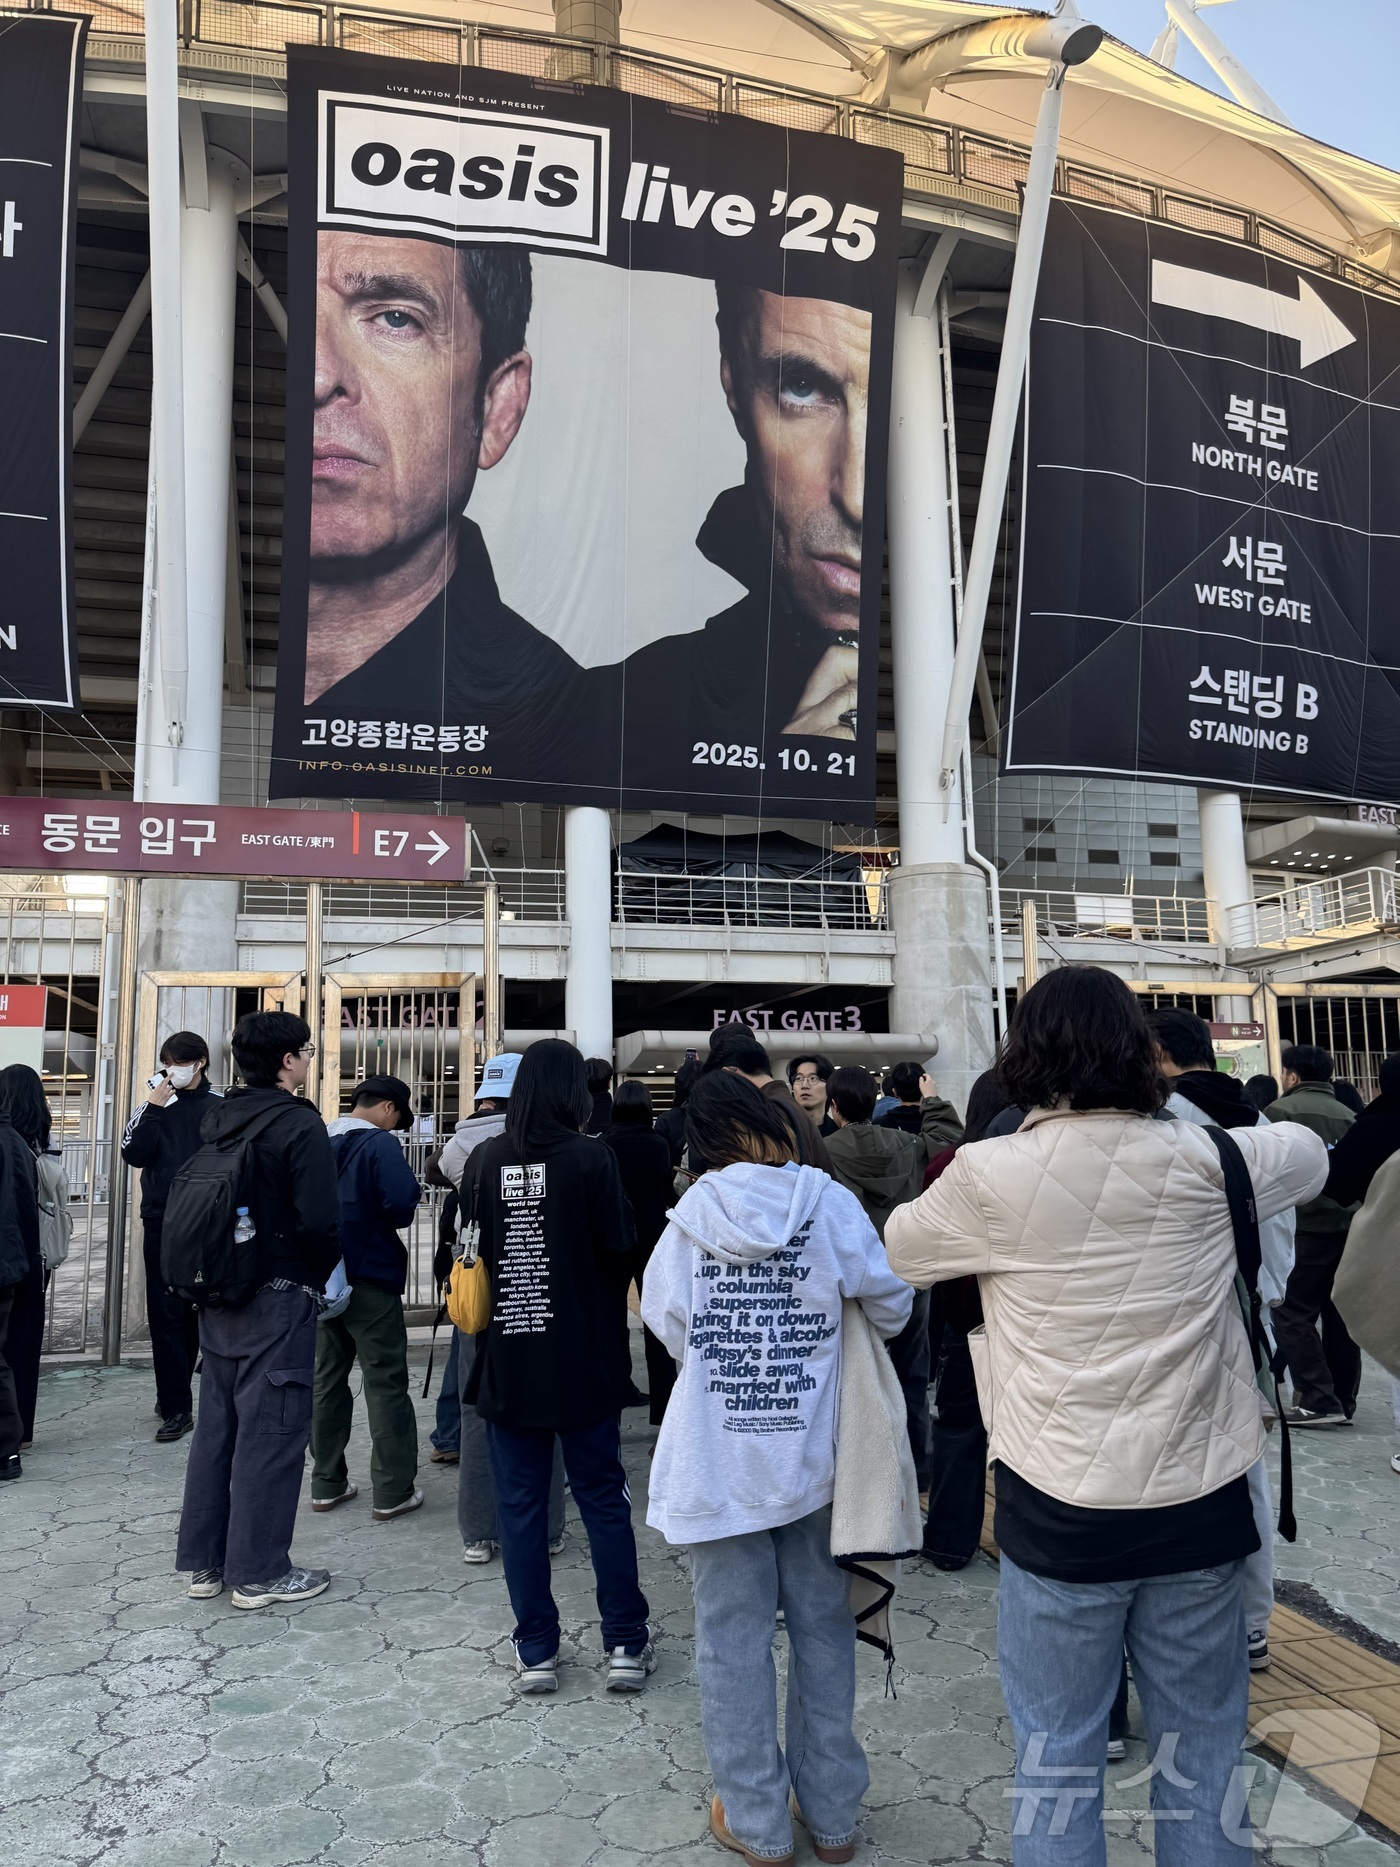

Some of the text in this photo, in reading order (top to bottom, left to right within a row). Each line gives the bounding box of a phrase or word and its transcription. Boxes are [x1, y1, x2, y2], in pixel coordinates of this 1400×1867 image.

[386, 84, 545, 111] LIVE NATION AND SJM PRESENT
[350, 142, 880, 262] oasis live '25
[1224, 394, 1289, 451] 북문
[1191, 441, 1319, 491] NORTH GATE
[1221, 536, 1287, 586] 서문
[1194, 583, 1312, 624] WEST GATE
[1188, 665, 1319, 720] 스탠딩 B
[301, 719, 489, 753] 고양종합운동장
[1188, 719, 1309, 755] STANDING B
[692, 742, 856, 777] 2025. 10. 21
[1357, 804, 1397, 825] EAST
[41, 813, 217, 857] 동문 입구
[241, 833, 271, 846] EAST
[272, 835, 303, 848] GATE
[374, 829, 410, 857] E7
[506, 1170, 540, 1181] oasis
[505, 1187, 524, 1198] live
[702, 1266, 721, 1280] up
[726, 1262, 742, 1277] in
[748, 1263, 773, 1277] the
[778, 1263, 811, 1281] sky
[717, 1278, 793, 1293] columbia
[709, 1295, 802, 1313] supersonic
[692, 1311, 826, 1330] bring it on down
[768, 1328, 777, 1343] &
[780, 1320, 839, 1343] alcohol
[704, 1344, 762, 1364] digsy's
[767, 1344, 817, 1360] dinner
[719, 1362, 760, 1377] slide
[765, 1363, 804, 1379] away
[710, 1379, 780, 1395] married
[785, 1374, 816, 1393] with
[725, 1394, 798, 1410] children
